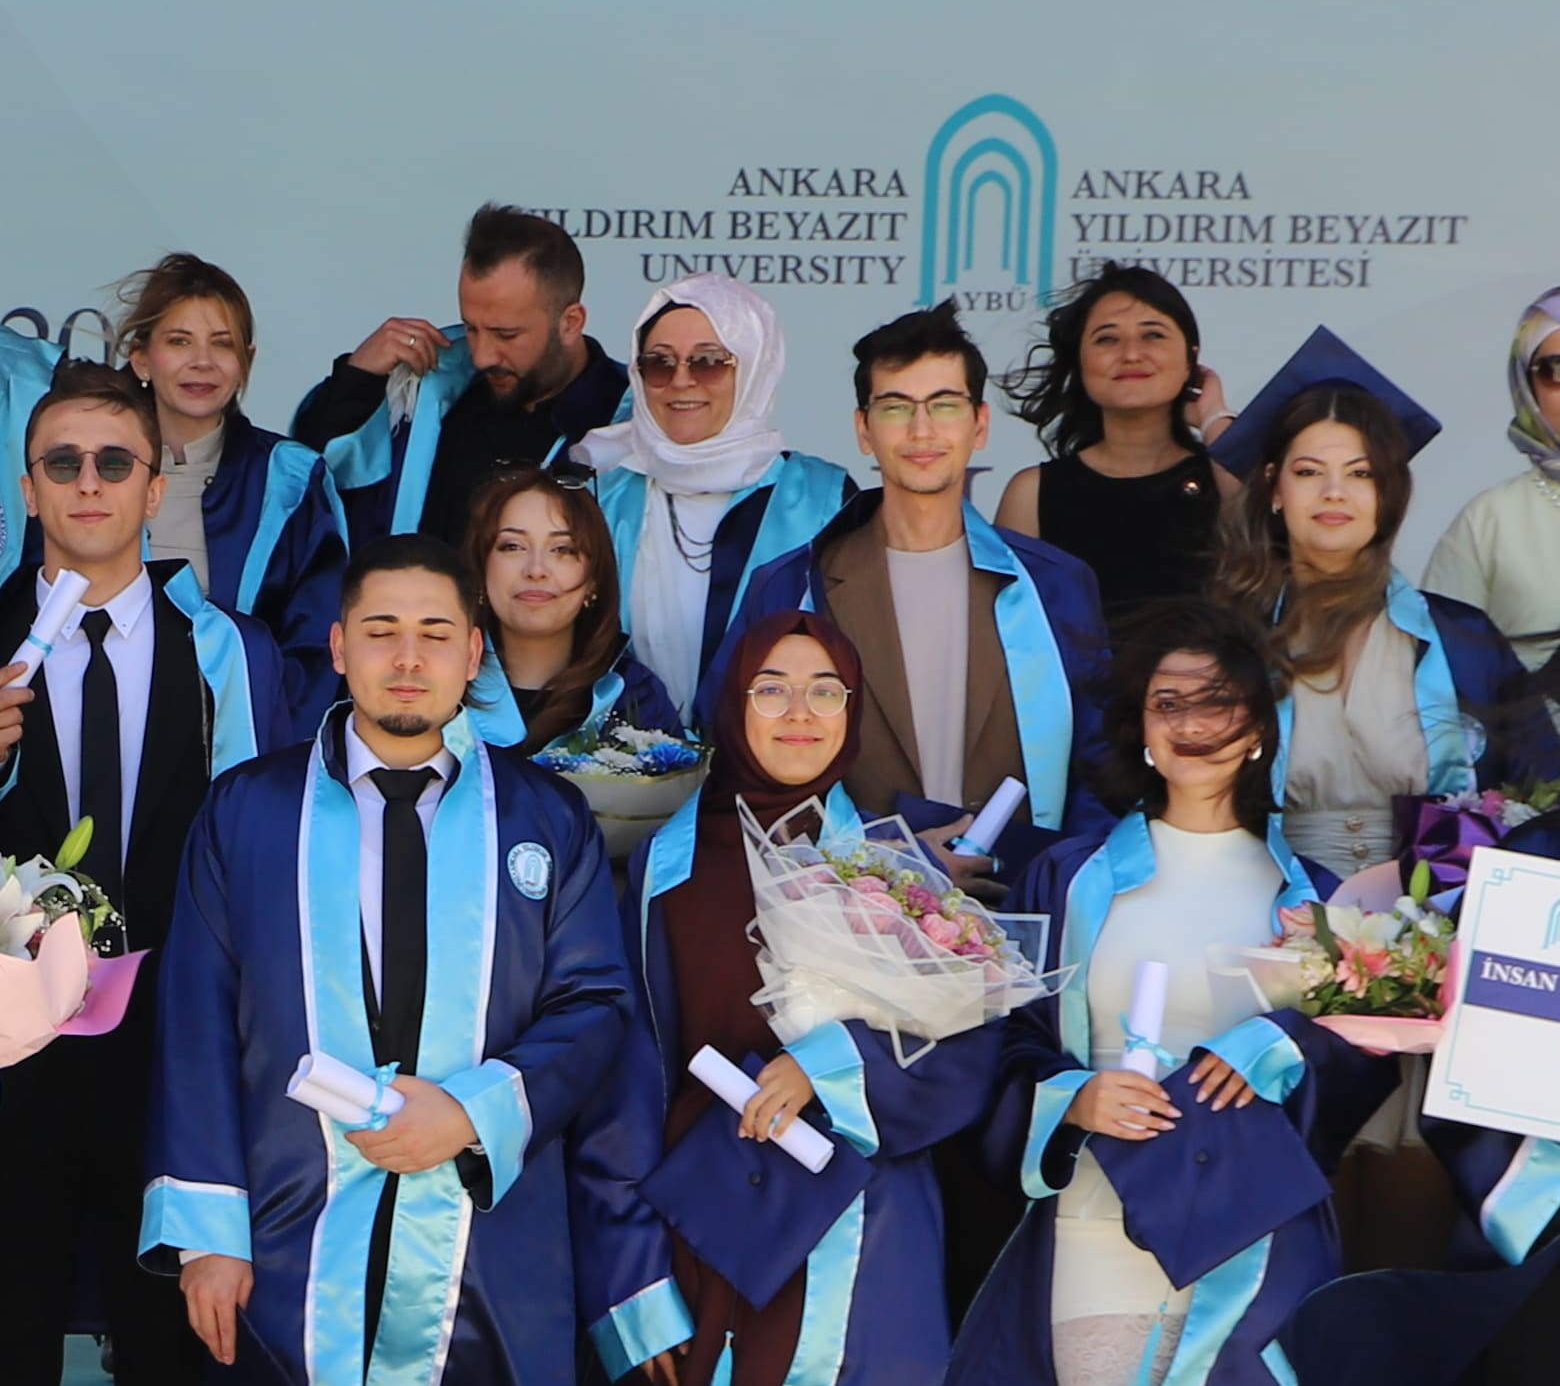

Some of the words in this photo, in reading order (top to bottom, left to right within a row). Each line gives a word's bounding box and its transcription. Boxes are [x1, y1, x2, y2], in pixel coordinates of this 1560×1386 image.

[728, 167, 908, 198] ANKARA
[1071, 170, 1252, 200] ANKARA
[530, 208, 714, 240] LDIRIM
[728, 210, 909, 241] BEYAZIT
[1070, 213, 1274, 244] YILDIRIM
[1288, 214, 1468, 244] BEYAZIT
[640, 253, 906, 285] UNIVERSITY
[1480, 957, 1560, 995] İNSAN
